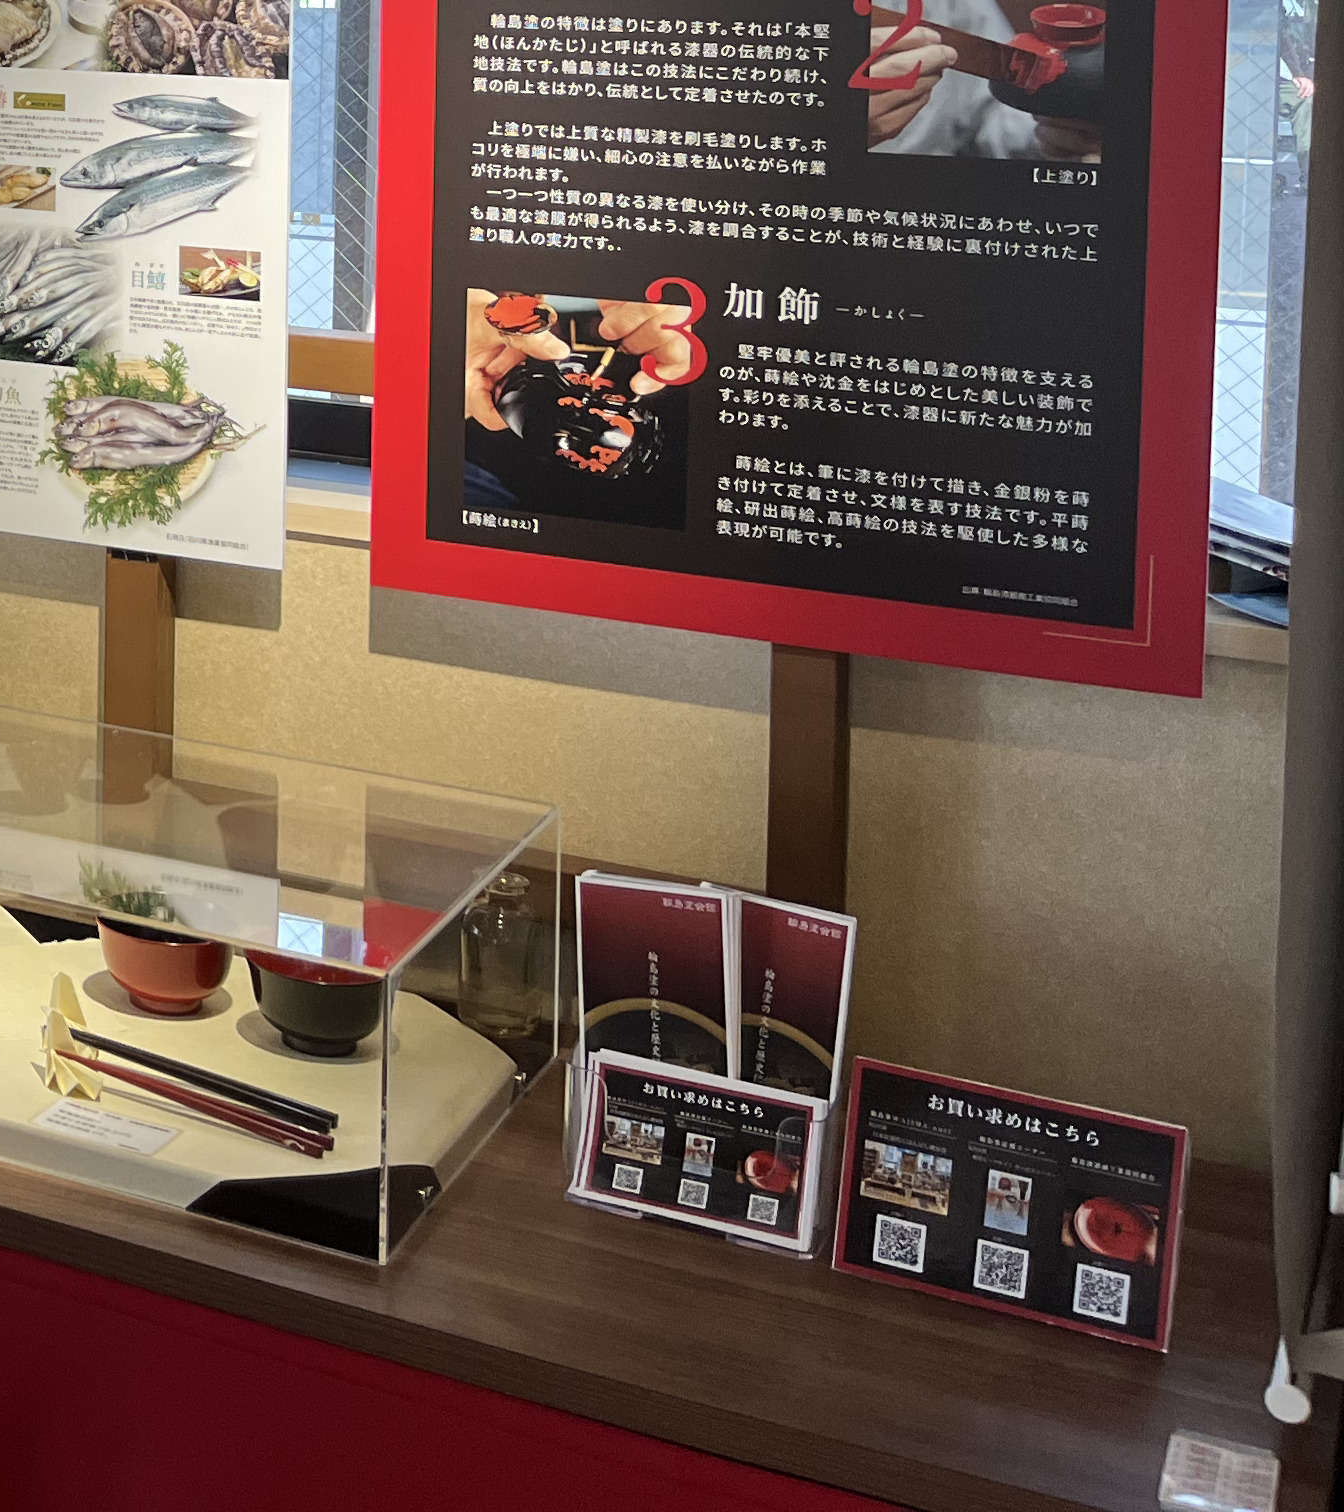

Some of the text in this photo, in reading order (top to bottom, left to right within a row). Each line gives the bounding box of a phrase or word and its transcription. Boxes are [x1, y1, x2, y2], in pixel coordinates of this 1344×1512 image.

[490, 13, 831, 39] 輪島塗の特徴は塗りにあります。それは「本堅
[473, 35, 830, 62] 地(ほんかたじ)」と呼ばれる漆器の伝統的な下
[473, 57, 828, 86] 地技法です。輪島塗はこの技法にこだわり続け、
[472, 78, 826, 108] 質の向上をはかり、伝統として定着させたのです。
[488, 121, 827, 152] 上塗りでは上質な精製漆を刷毛塗りします。ホ
[471, 164, 570, 184] が行われます。
[472, 143, 827, 176] コリを極端に嫌い、細心の注意を払いながら作業
[1031, 168, 1099, 187] 【上塗り】
[486, 188, 1100, 238] 一つ一つ性質の異なる漆を使い分け、その時の季節や気候状況にあわせ、いつで
[470, 205, 1098, 263] も最適な塗膜が得られるよう、漆を調合することが、技術と経験に裏付けされた上
[723, 282, 821, 326] 加飾
[640, 276, 709, 386] 3
[738, 343, 1095, 389] 堅牢優美と評される輪島塗の特徴を支える
[719, 365, 1094, 412] のが、蒔絵や沈金をはじめとした美しい装飾で
[718, 387, 1093, 437] す。彩りを添えることで、漆器に新たな魅力が加
[718, 409, 790, 431] わります。
[735, 454, 1090, 508] 蒔絵とは、筆に漆を付けて描き、金銀粉を蒔
[717, 476, 1089, 531] き付けて定着させ、文様を表す技法です。平蒔
[716, 497, 1089, 554] 絵、研出蒔絵、高蒔絵の技法を駆使した多様な
[716, 519, 844, 549] 表現が可能です。
[642, 1080, 765, 1119] お買い求めはこちら
[927, 1093, 1100, 1148] お買い求めはこちら
